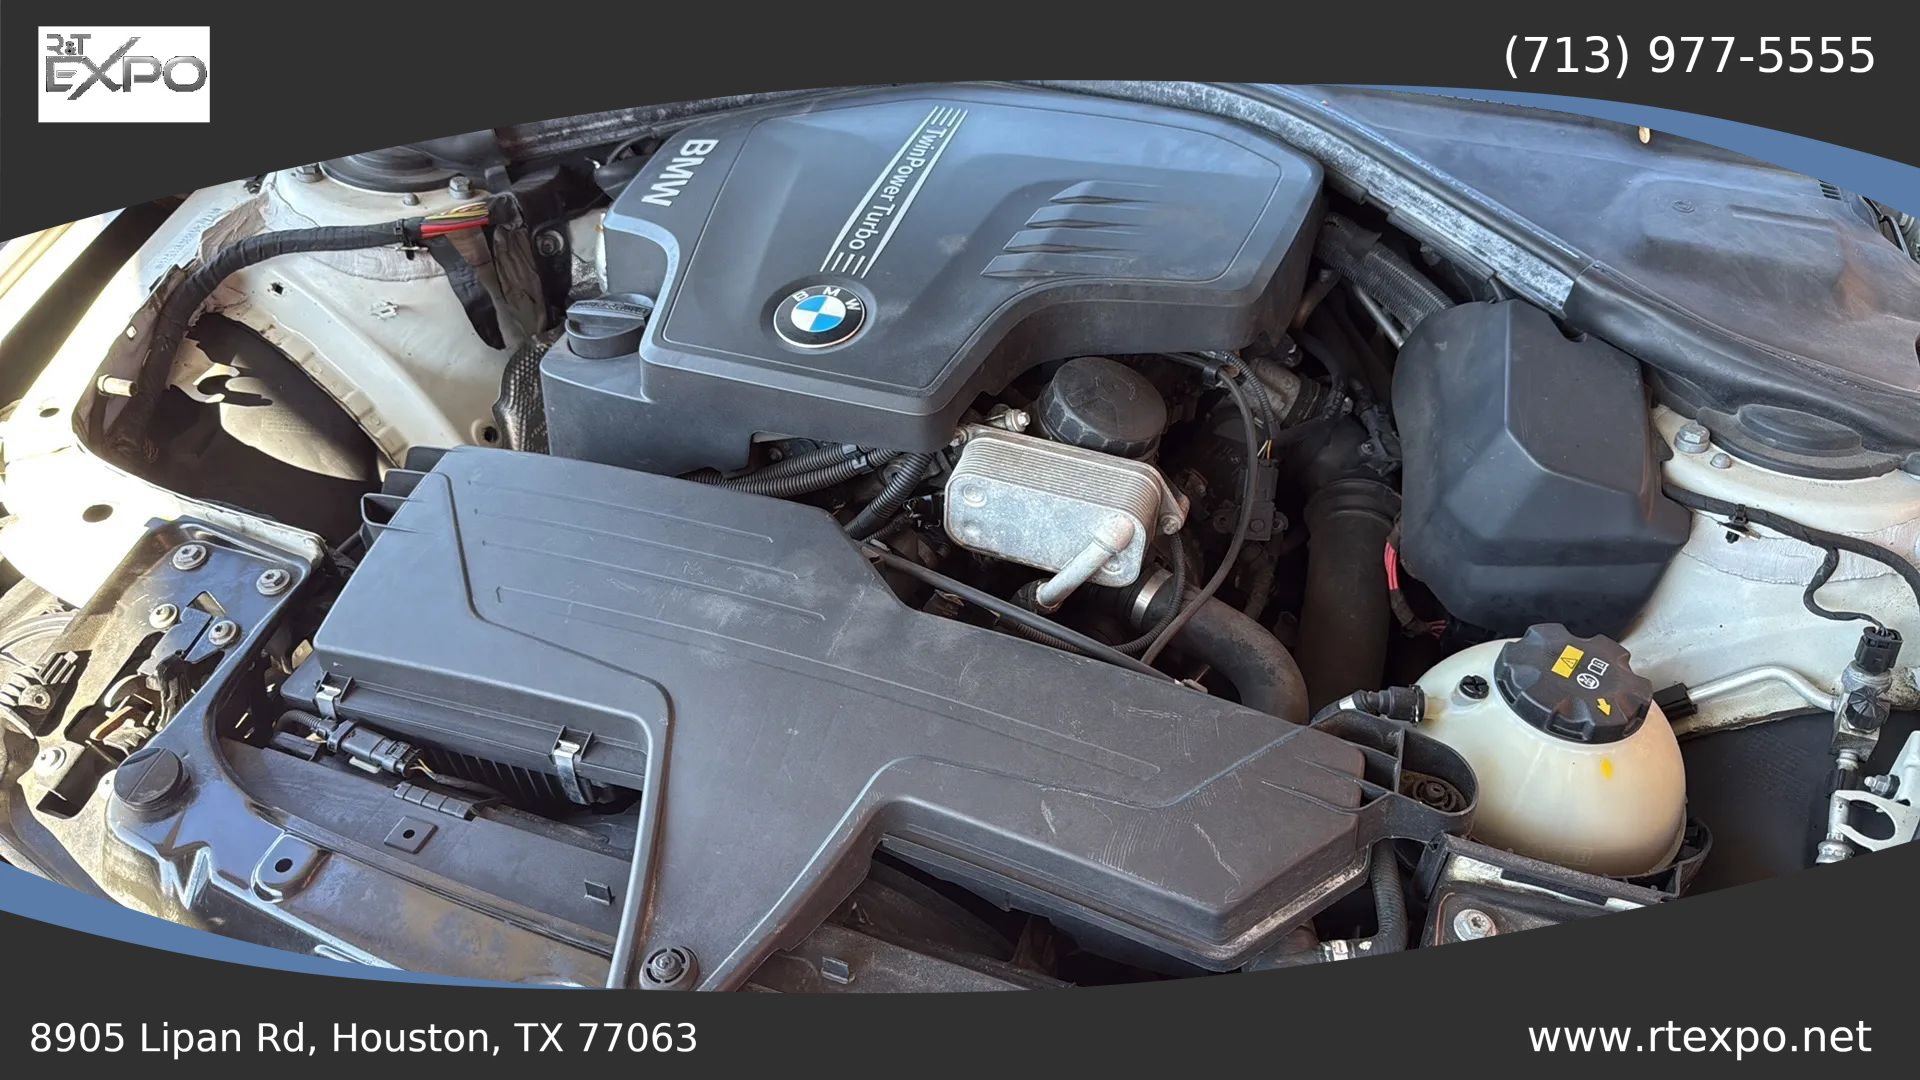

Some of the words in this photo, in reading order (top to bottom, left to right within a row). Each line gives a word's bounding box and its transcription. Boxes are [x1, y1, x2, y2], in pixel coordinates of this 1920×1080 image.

[641, 139, 720, 207] BMW
[880, 127, 948, 202] TwinPower
[849, 204, 896, 250] Turbo
[792, 286, 862, 311] BMW
